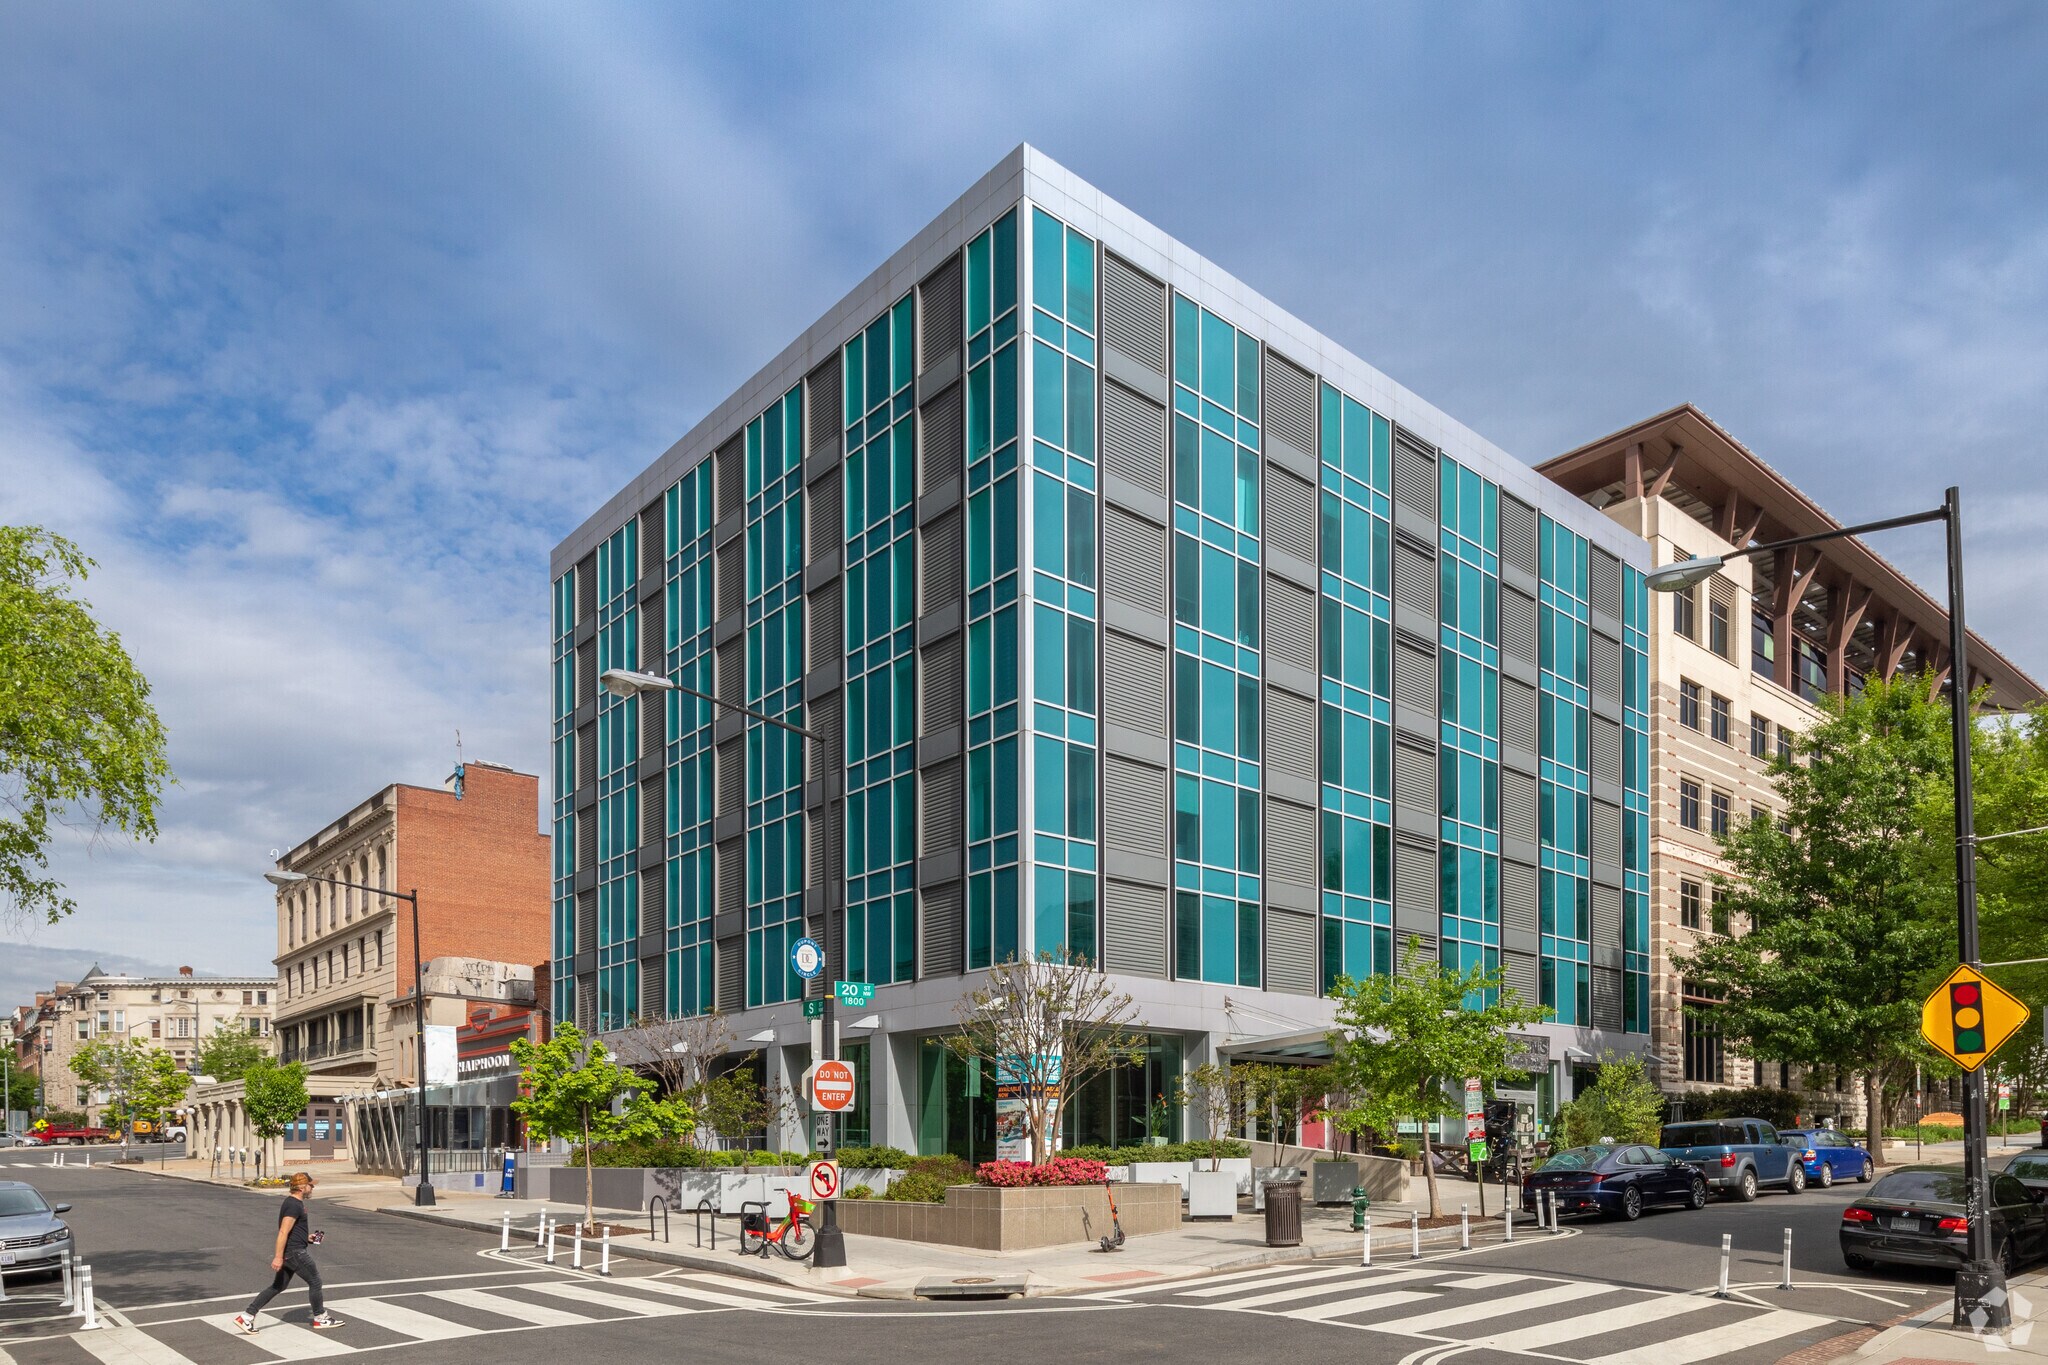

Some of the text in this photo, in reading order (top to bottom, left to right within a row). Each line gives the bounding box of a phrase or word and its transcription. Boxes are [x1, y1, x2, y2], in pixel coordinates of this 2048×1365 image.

[797, 939, 817, 947] DUPONT
[797, 967, 817, 977] CIRCLE
[841, 984, 858, 996] 20
[844, 997, 864, 1006] 1800
[808, 1002, 815, 1014] S
[457, 1054, 509, 1072] HAIPHOON
[819, 1070, 849, 1080] DO NOT
[822, 1092, 846, 1101] ENTER
[816, 1116, 829, 1126] ONE
[816, 1127, 830, 1137] WAY
